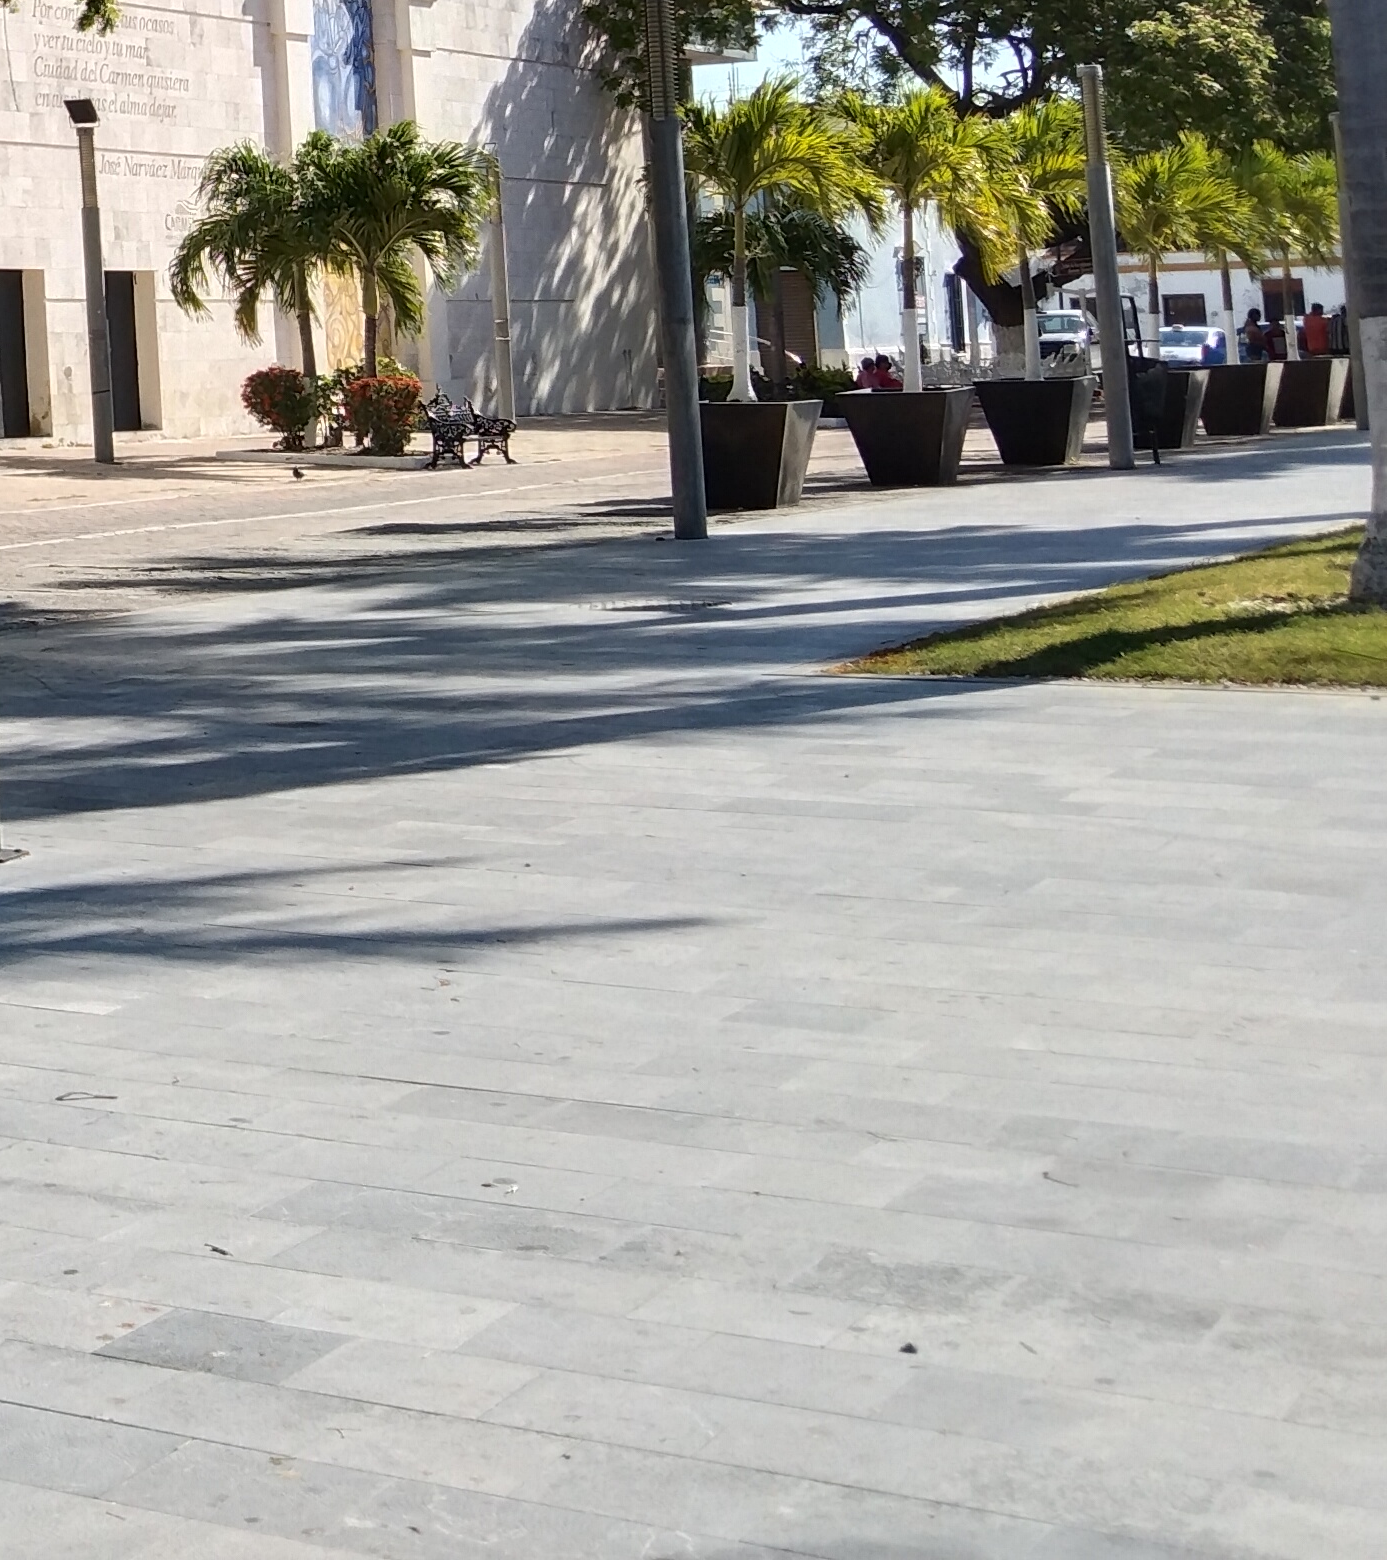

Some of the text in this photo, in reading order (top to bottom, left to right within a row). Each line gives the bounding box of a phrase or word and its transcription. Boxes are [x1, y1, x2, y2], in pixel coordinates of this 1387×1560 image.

[139, 16, 175, 36] ocasos
[33, 33, 41, 53] y
[42, 34, 60, 51] ver
[61, 34, 74, 51] tu
[76, 34, 102, 54] cielo
[102, 41, 111, 60] y
[112, 41, 123, 57] tu
[34, 56, 190, 95] Ciudad del Carmen quisiera
[35, 92, 50, 108] en
[108, 93, 118, 114] el
[119, 95, 147, 116] alma
[149, 97, 178, 123] dejar.
[98, 154, 204, 186] José Narváez Márq
